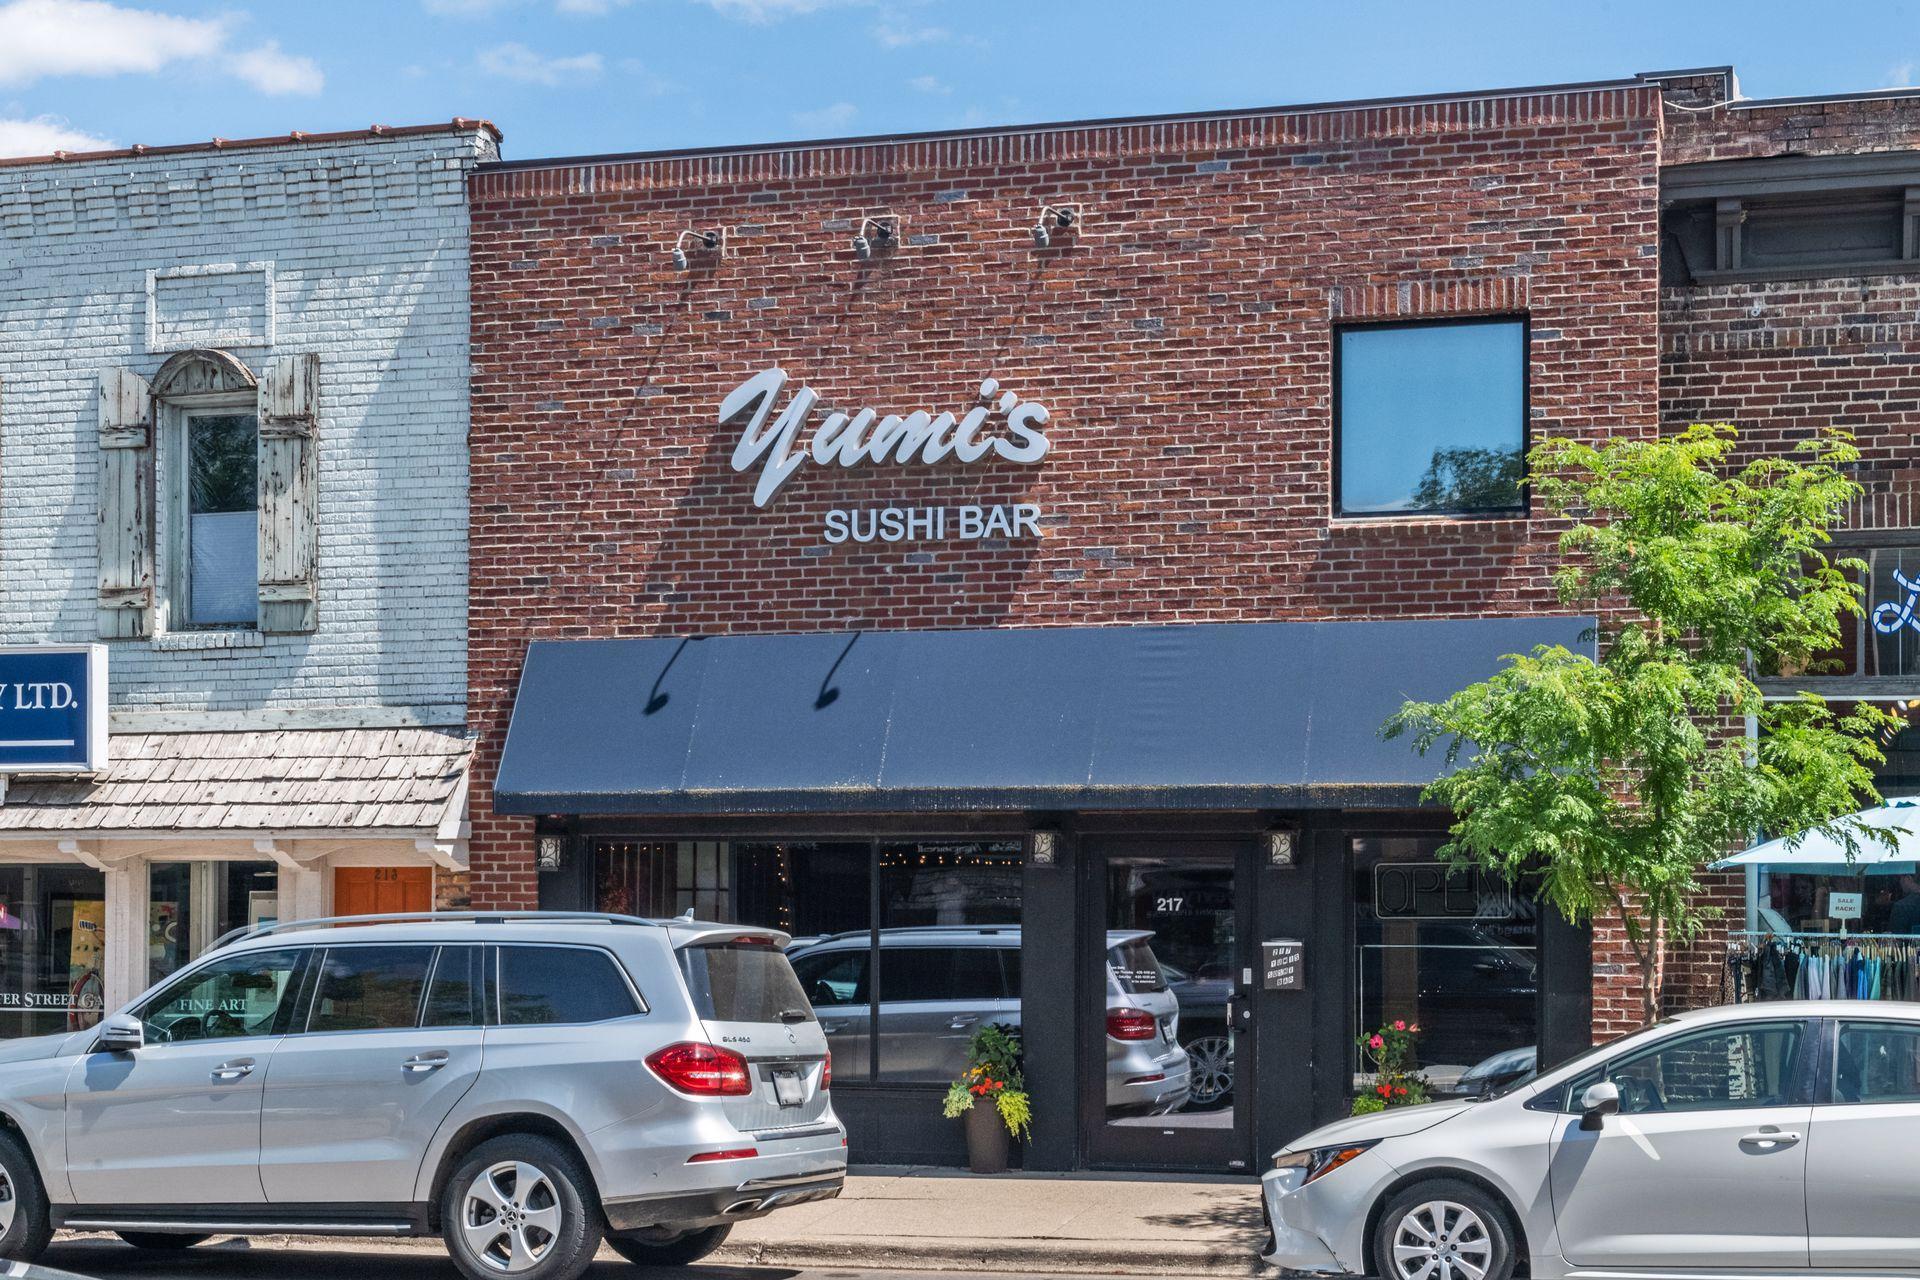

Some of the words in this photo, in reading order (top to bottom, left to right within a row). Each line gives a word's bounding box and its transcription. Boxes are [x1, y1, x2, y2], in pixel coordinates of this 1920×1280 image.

[718, 367, 1051, 508] Yumi's
[823, 505, 945, 543] SUSHI
[959, 503, 1044, 539] BAR
[13, 682, 78, 710] LTD.
[1156, 897, 1183, 912] 217
[1381, 868, 1505, 913] OPEN
[24, 992, 78, 1008] STREET
[180, 999, 214, 1011] FINE
[218, 999, 246, 1011] ART
